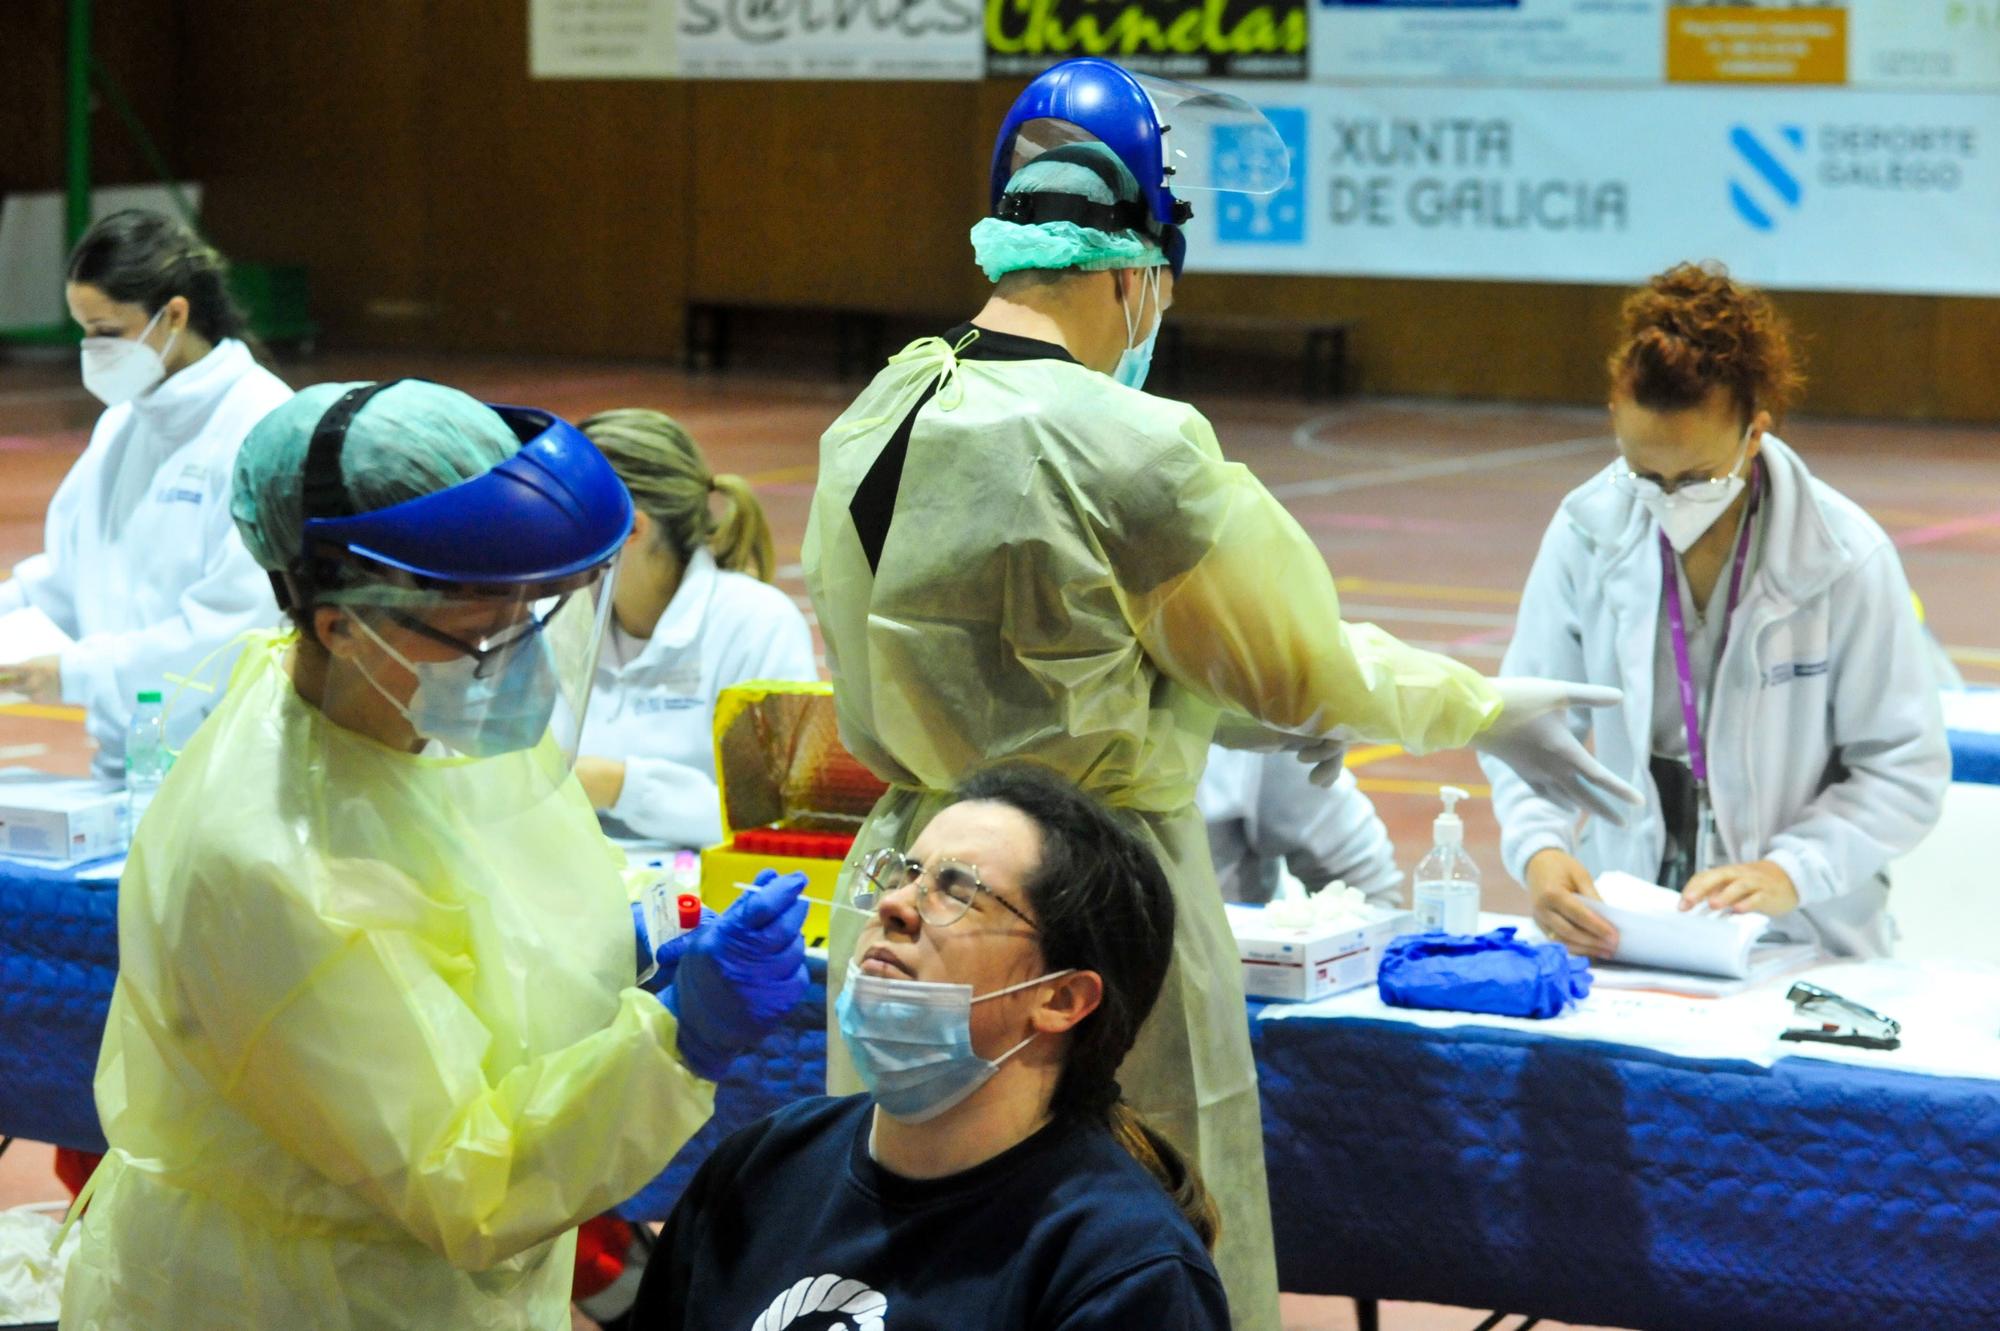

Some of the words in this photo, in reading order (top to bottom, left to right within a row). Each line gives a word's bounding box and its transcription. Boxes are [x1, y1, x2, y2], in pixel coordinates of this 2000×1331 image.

[1330, 118, 1513, 167] XUNTA
[1819, 124, 1977, 157] DEPORTE
[1816, 159, 1963, 191] GALEGO
[1328, 176, 1396, 227] DE
[1405, 178, 1629, 232] GALICIA
